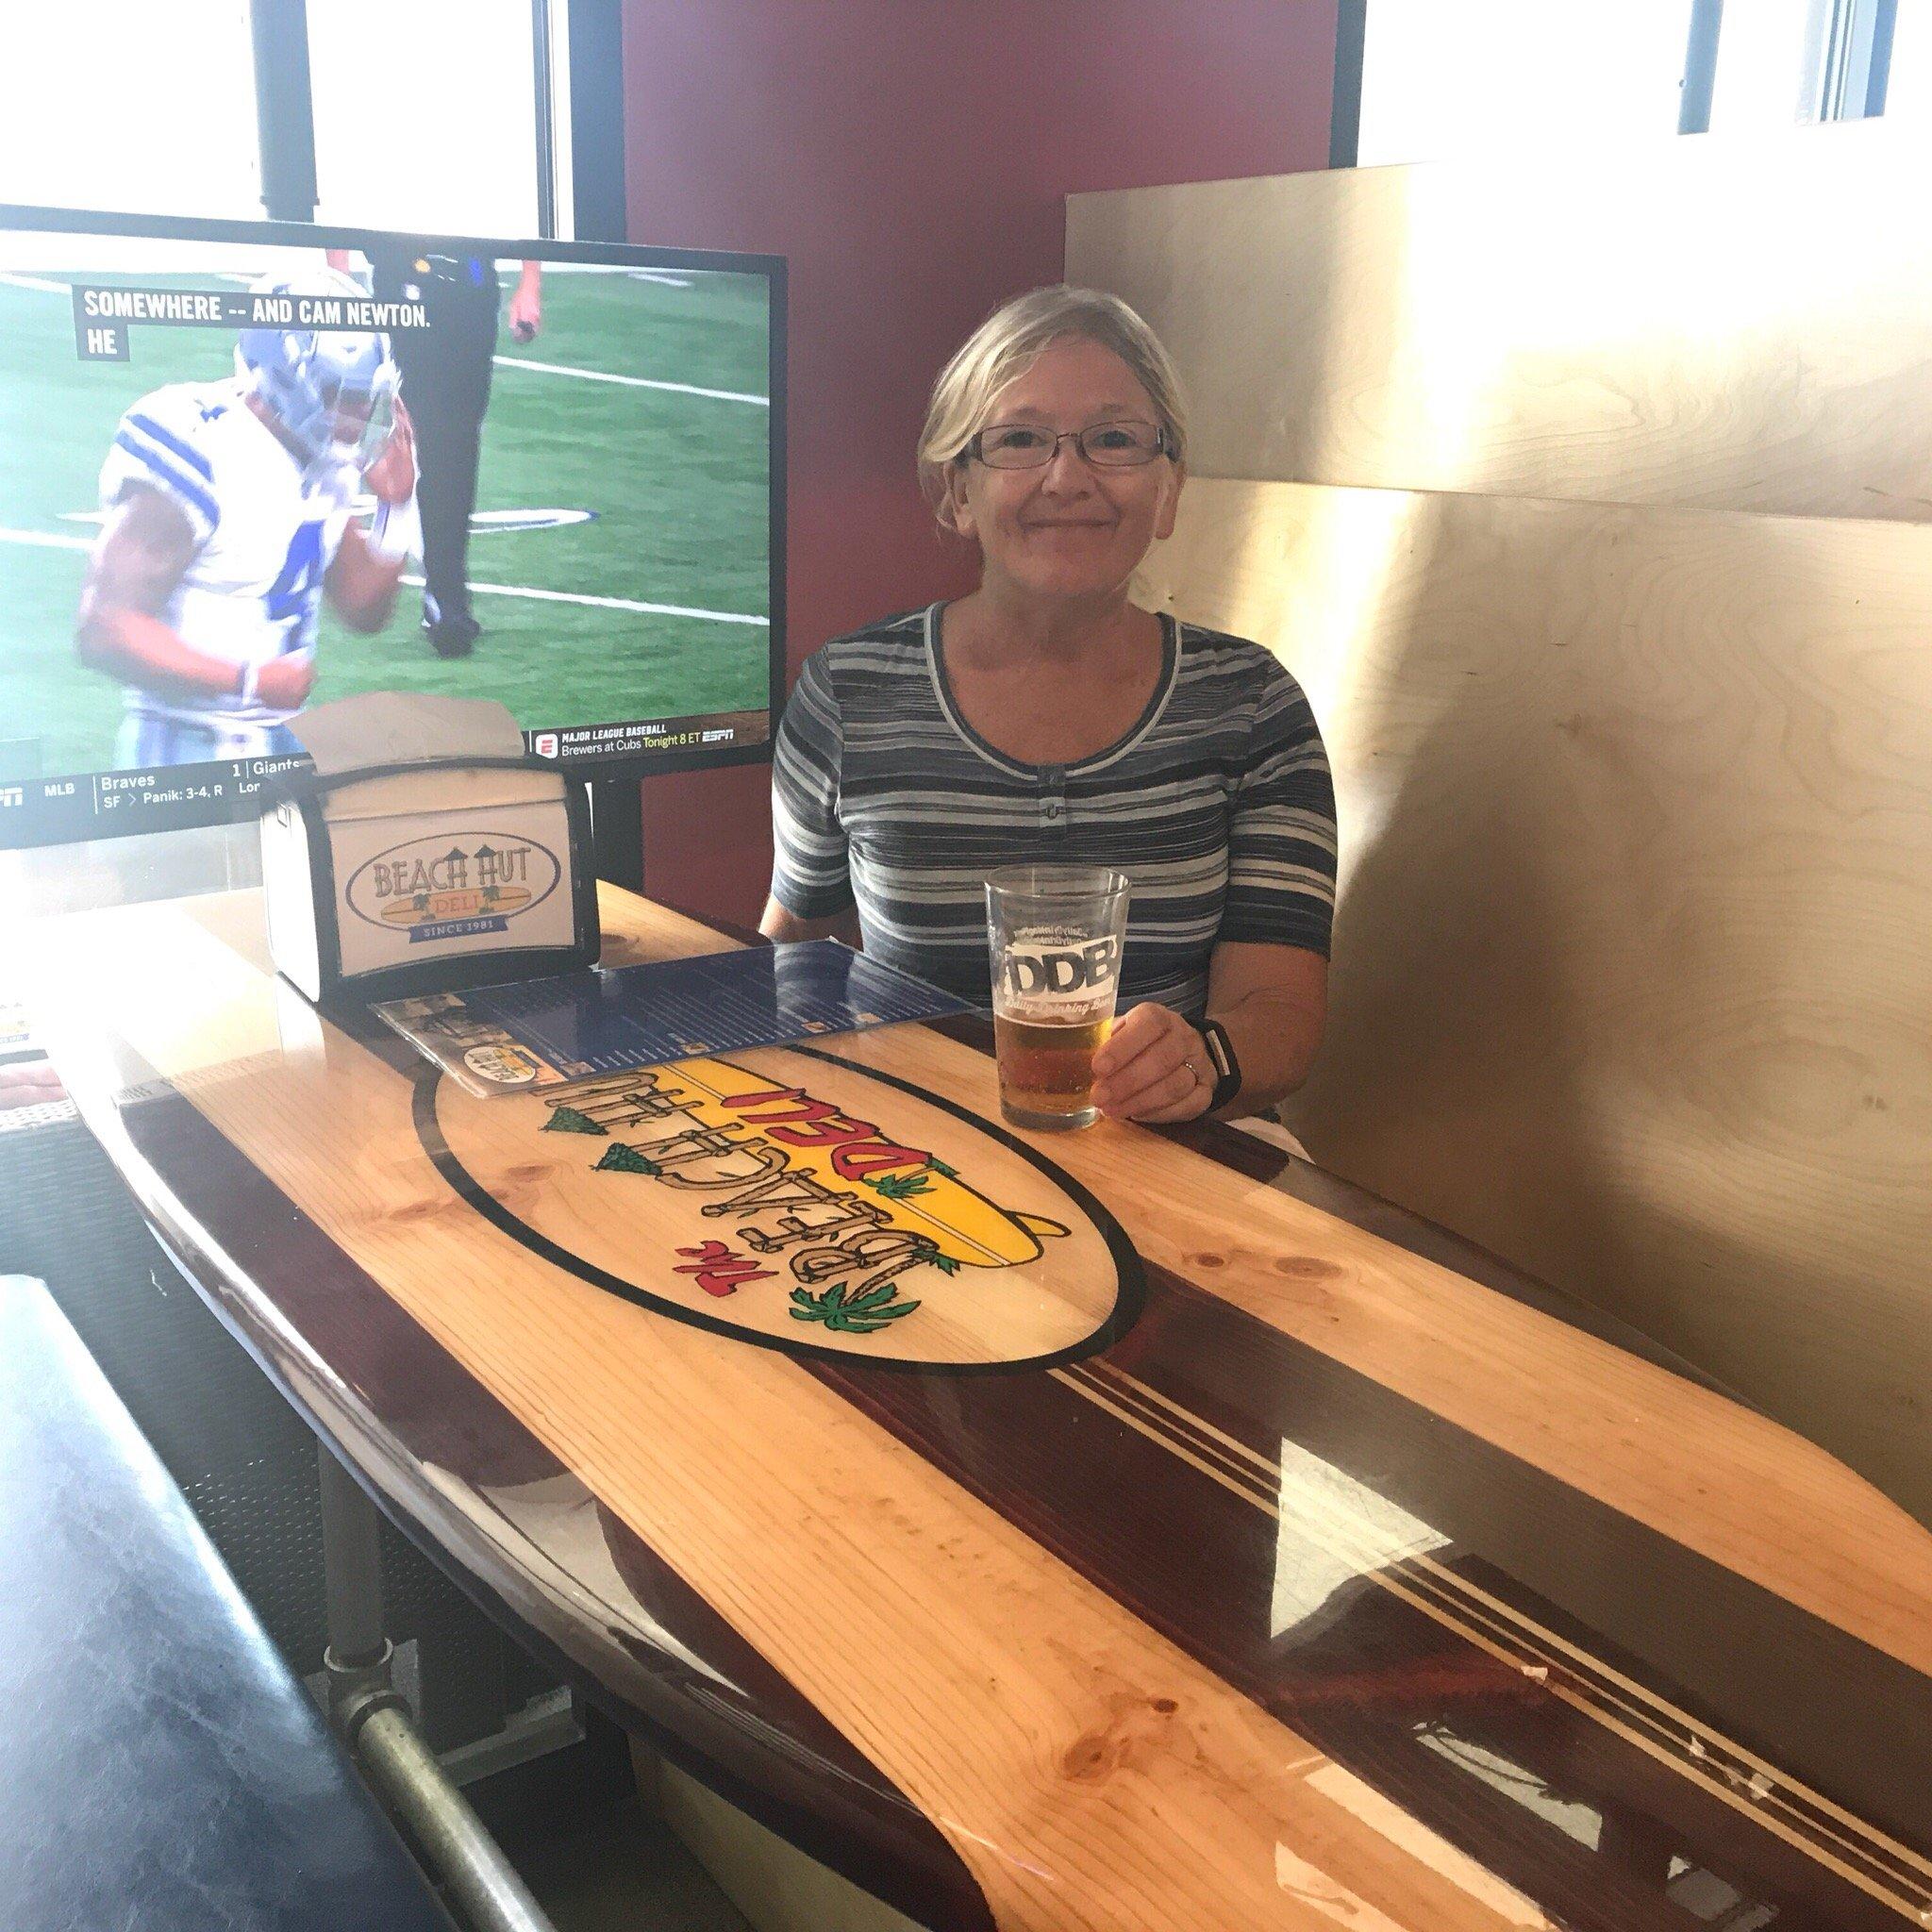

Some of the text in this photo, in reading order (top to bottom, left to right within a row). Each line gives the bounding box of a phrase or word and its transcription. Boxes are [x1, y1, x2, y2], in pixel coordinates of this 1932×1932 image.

[84, 290, 222, 321] SOMEWHERE
[253, 298, 293, 323] AND
[299, 300, 341, 325] CAM
[347, 303, 431, 327] NEWTON.
[87, 329, 118, 355] HE
[561, 724, 667, 743] MAJOR LEAGUE BASEBALL
[561, 729, 734, 757] Brewers at Cubs Tonight 8 ET ESPN
[101, 774, 156, 791] Braves
[232, 763, 241, 777] 1
[43, 782, 75, 797] MLB
[103, 795, 121, 809] SF
[142, 789, 183, 805] Panik:
[213, 785, 223, 796] R
[374, 843, 531, 898] BEACH HUT
[434, 894, 480, 914] DELI
[423, 920, 494, 938] SINCE 1981
[1007, 940, 1115, 994] DDB
[721, 1088, 933, 1181] DELI
[591, 1123, 941, 1284] BEACH
